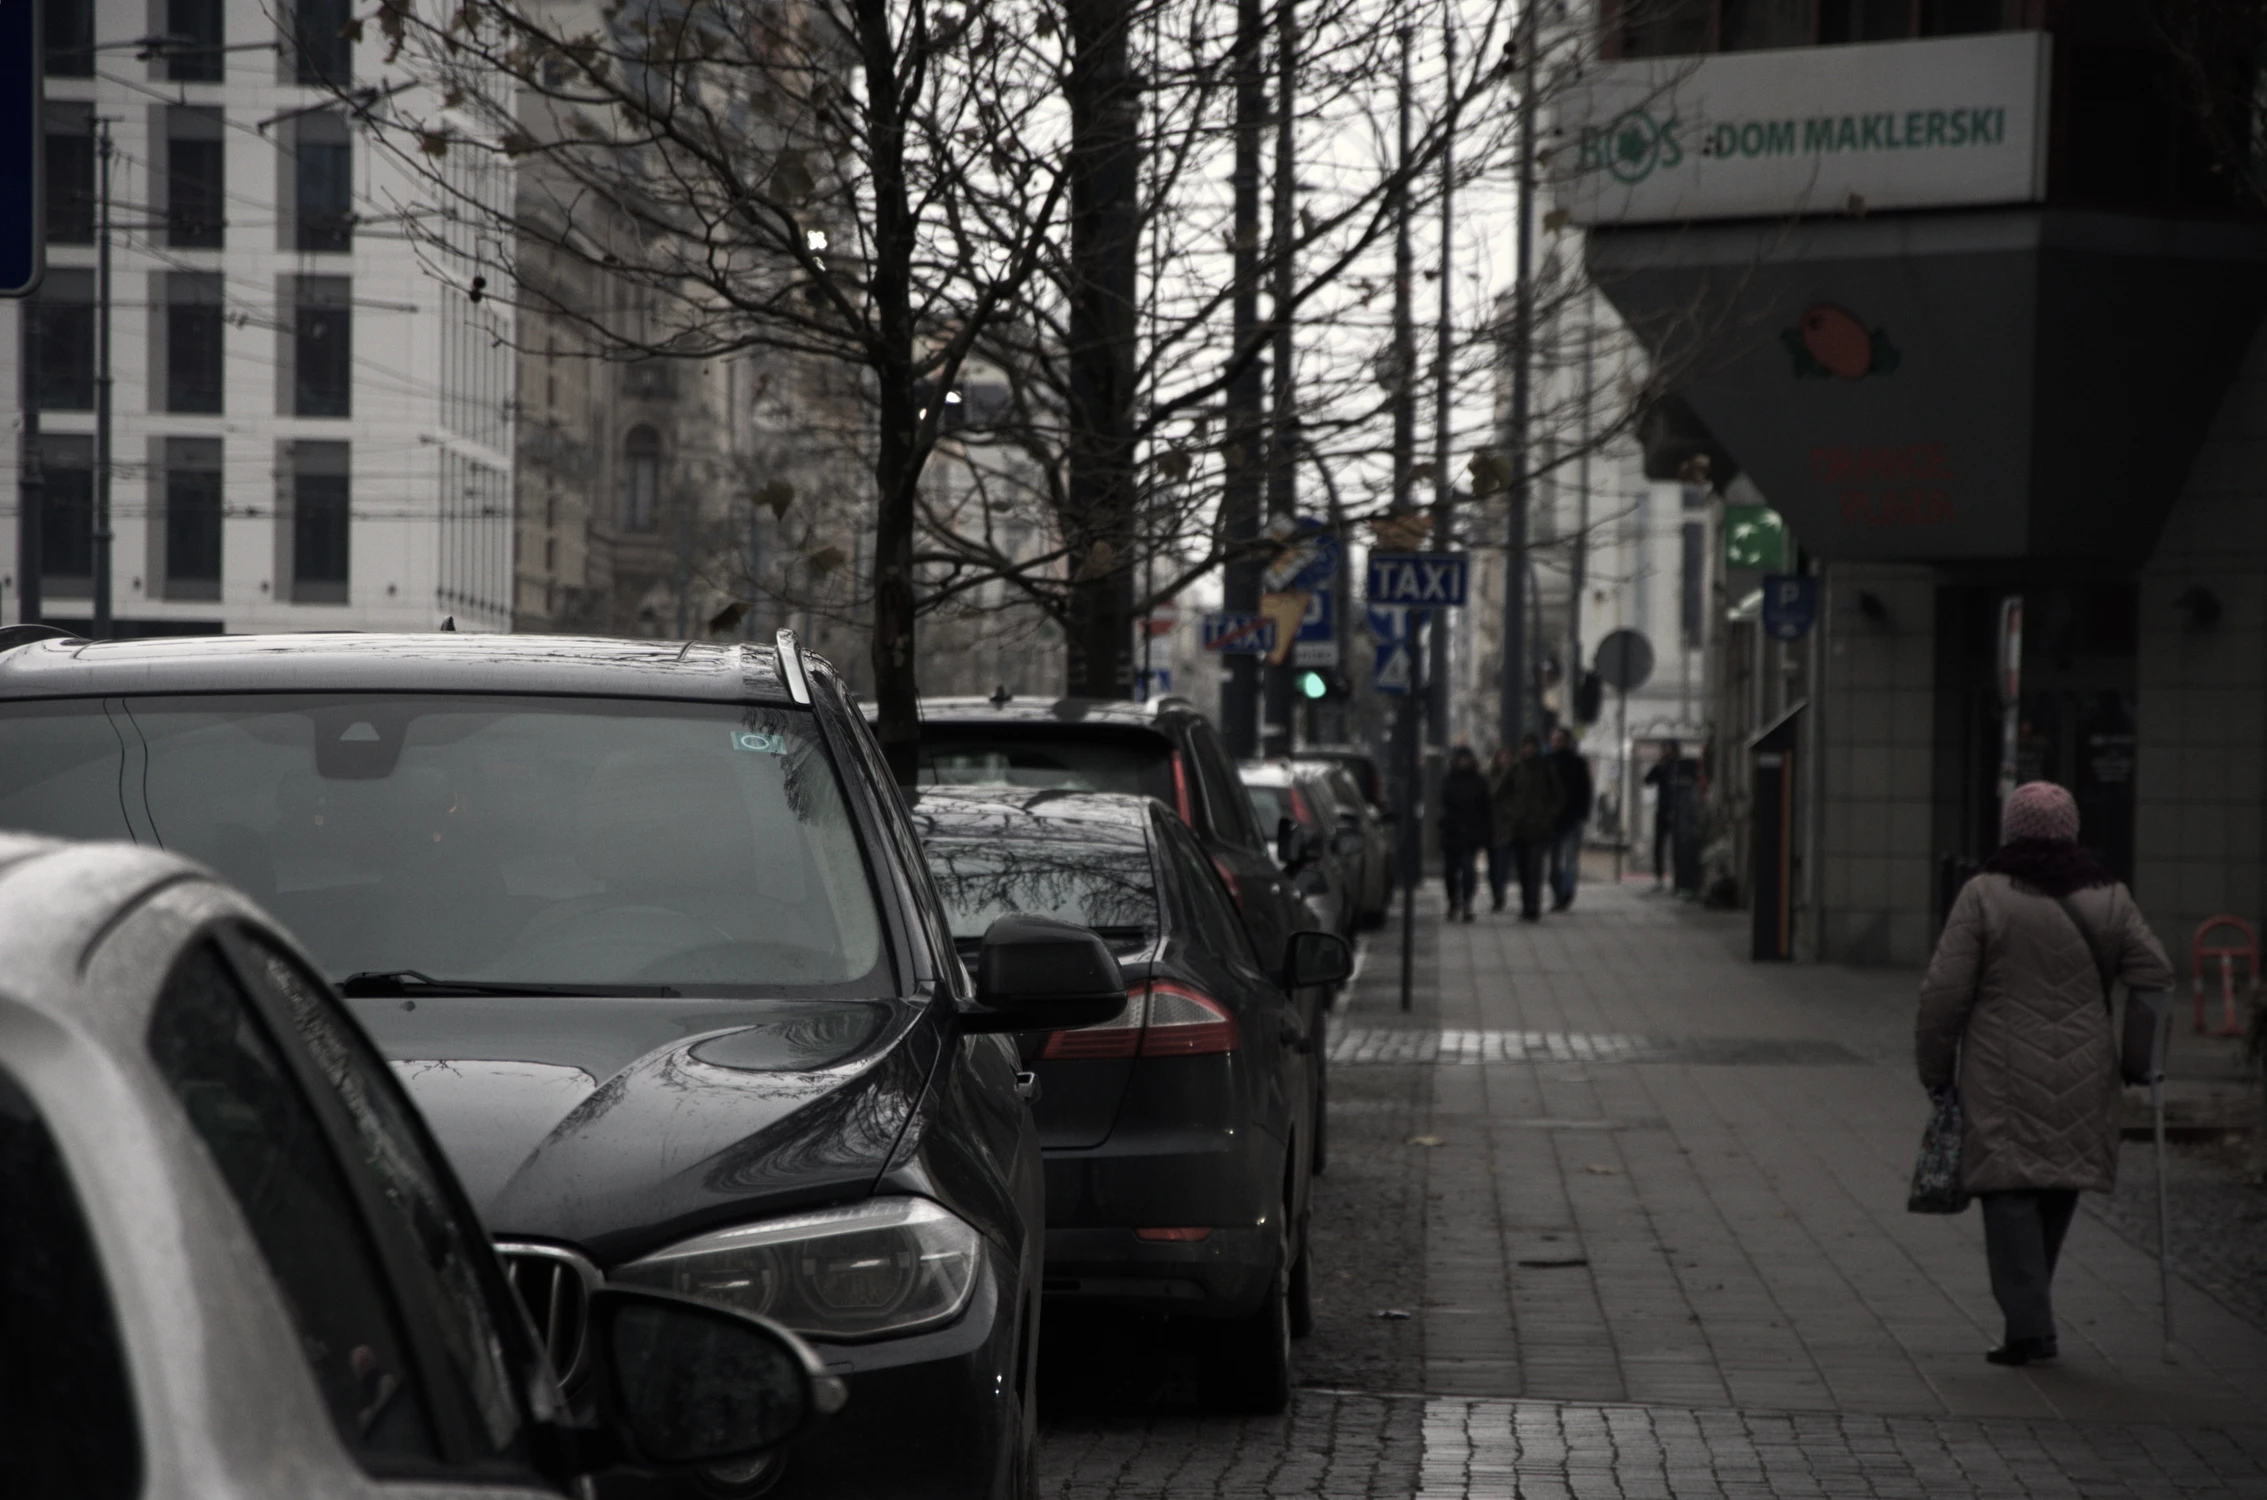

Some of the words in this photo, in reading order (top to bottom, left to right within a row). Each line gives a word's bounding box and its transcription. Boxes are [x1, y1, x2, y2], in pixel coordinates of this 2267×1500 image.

[1715, 121, 1796, 158] DOM
[1804, 108, 2006, 154] MAKLERSKI
[1373, 561, 1460, 600] TAXI
[1206, 616, 1273, 650] TAXI
